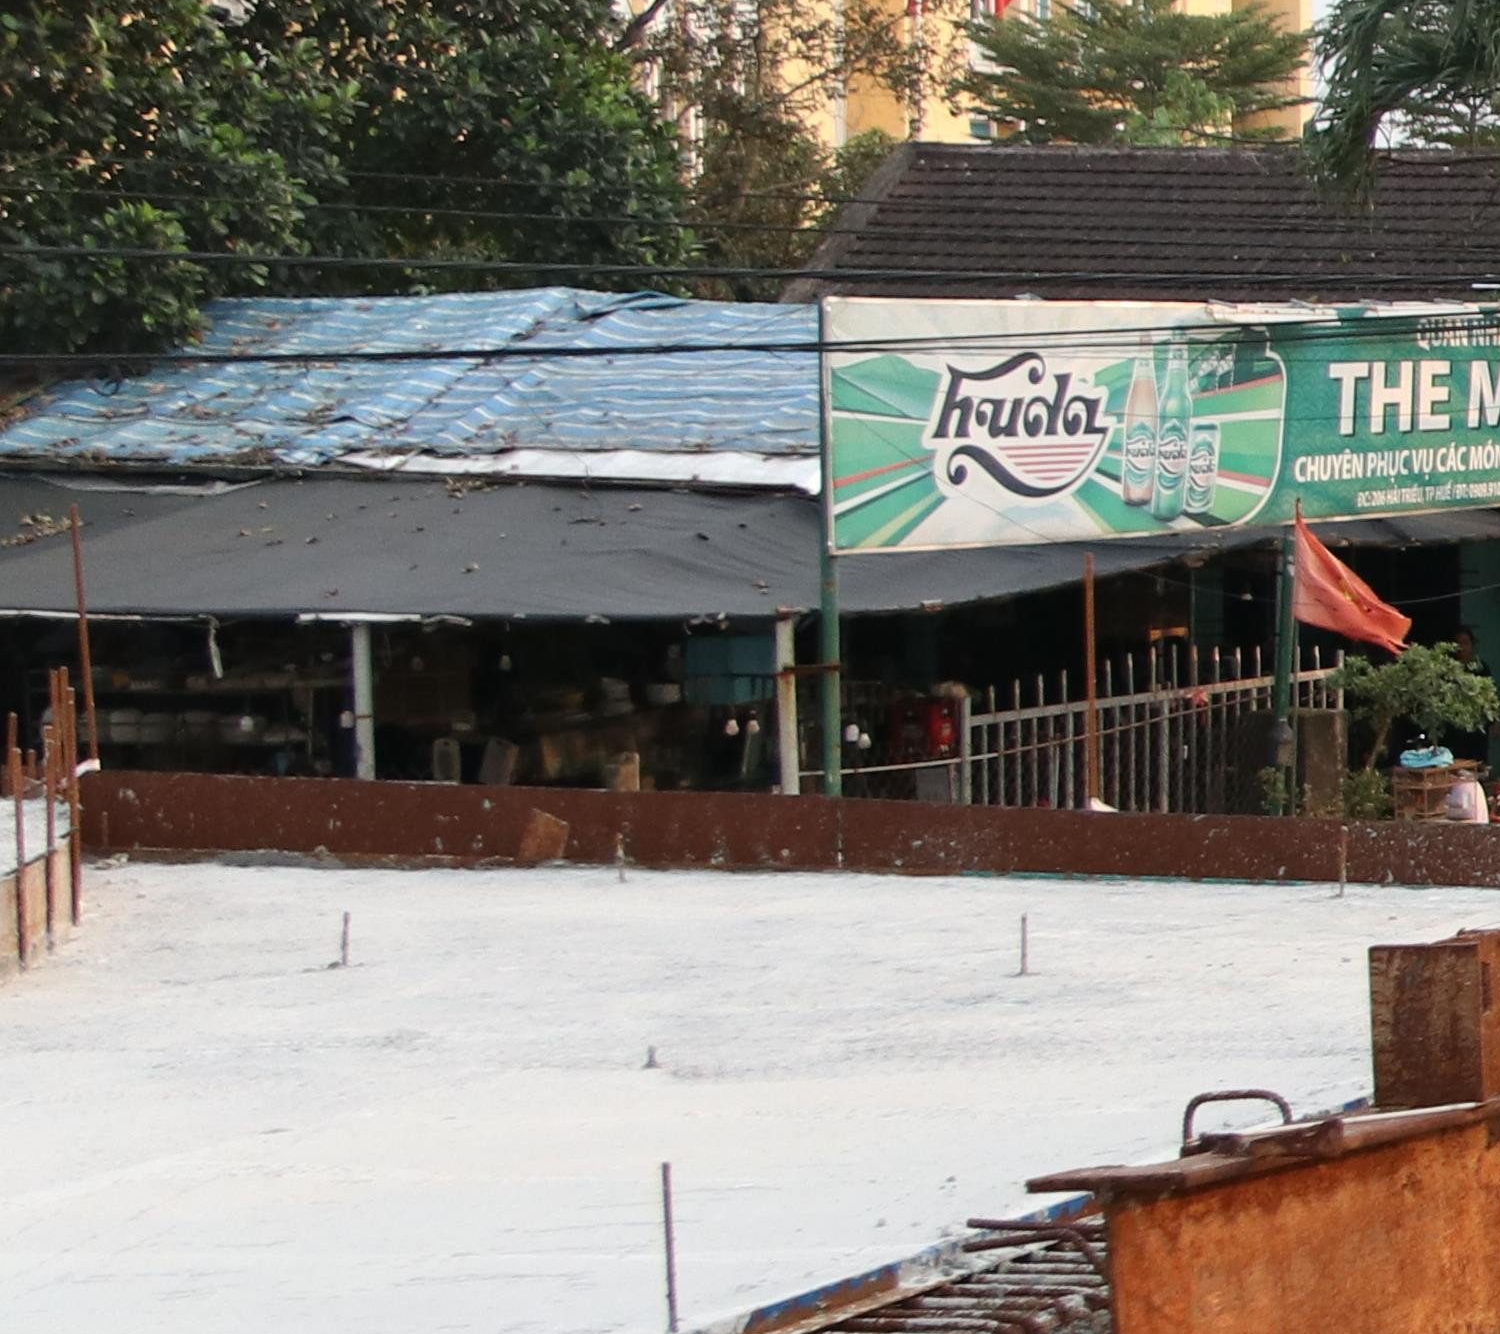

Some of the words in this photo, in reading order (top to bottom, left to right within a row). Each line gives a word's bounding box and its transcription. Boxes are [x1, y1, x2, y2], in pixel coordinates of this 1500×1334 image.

[932, 351, 1110, 441] huda
[1329, 359, 1452, 436] THE
[1294, 448, 1364, 483] CHUYÊN
[1366, 450, 1410, 484] PHỤC
[1411, 448, 1434, 480] VỤ
[1436, 442, 1467, 472] CÁC
